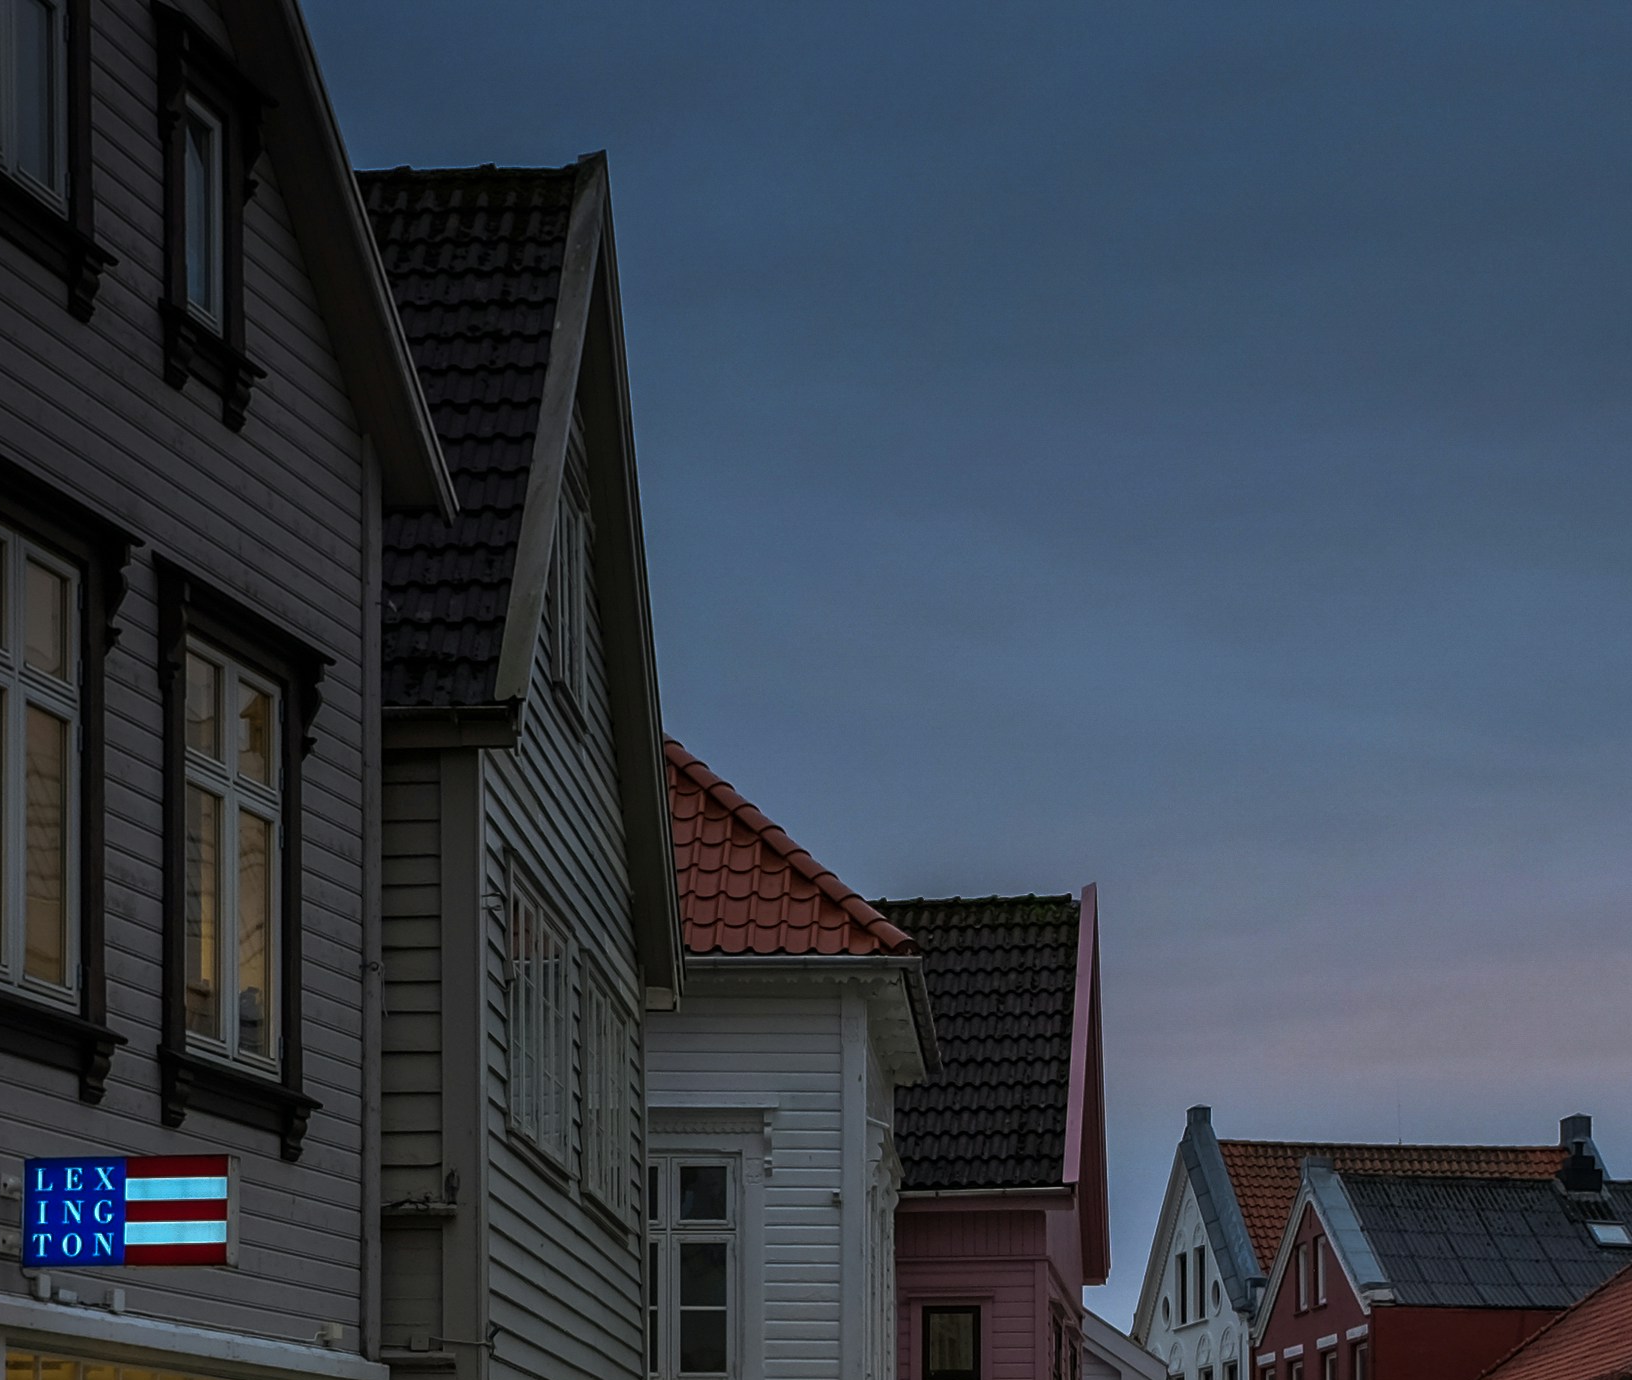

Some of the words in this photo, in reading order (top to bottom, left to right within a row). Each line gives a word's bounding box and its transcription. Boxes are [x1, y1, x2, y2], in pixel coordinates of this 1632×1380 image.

[34, 1166, 116, 1192] LEX
[37, 1200, 116, 1225] ING
[32, 1232, 116, 1258] TON
